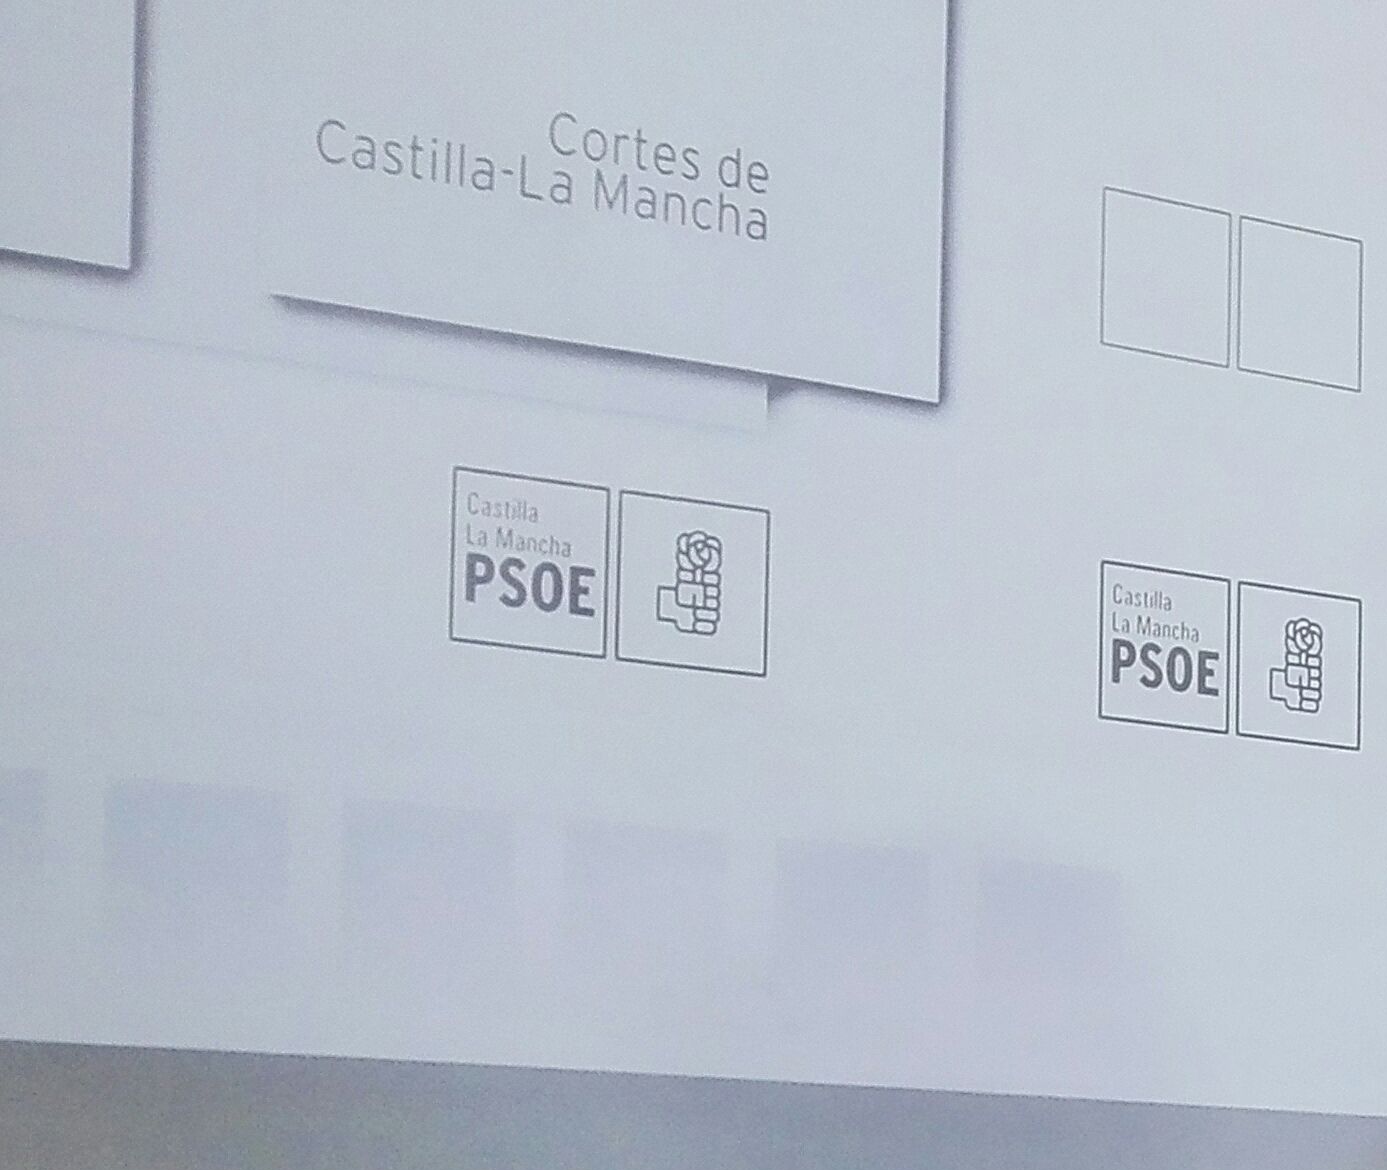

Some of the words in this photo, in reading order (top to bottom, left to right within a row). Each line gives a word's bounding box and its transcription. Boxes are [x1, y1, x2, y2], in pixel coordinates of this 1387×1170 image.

[549, 111, 702, 181] Cortes
[718, 147, 770, 194] de
[594, 168, 768, 241] Mancha
[467, 491, 539, 523] Castilla
[466, 522, 487, 547] La
[496, 526, 572, 558] Mancha
[465, 552, 596, 617] PSOE
[1112, 583, 1172, 611] Castilla
[1112, 611, 1130, 634] La
[1137, 614, 1200, 643] Mancha
[1112, 637, 1220, 697] PSOE
